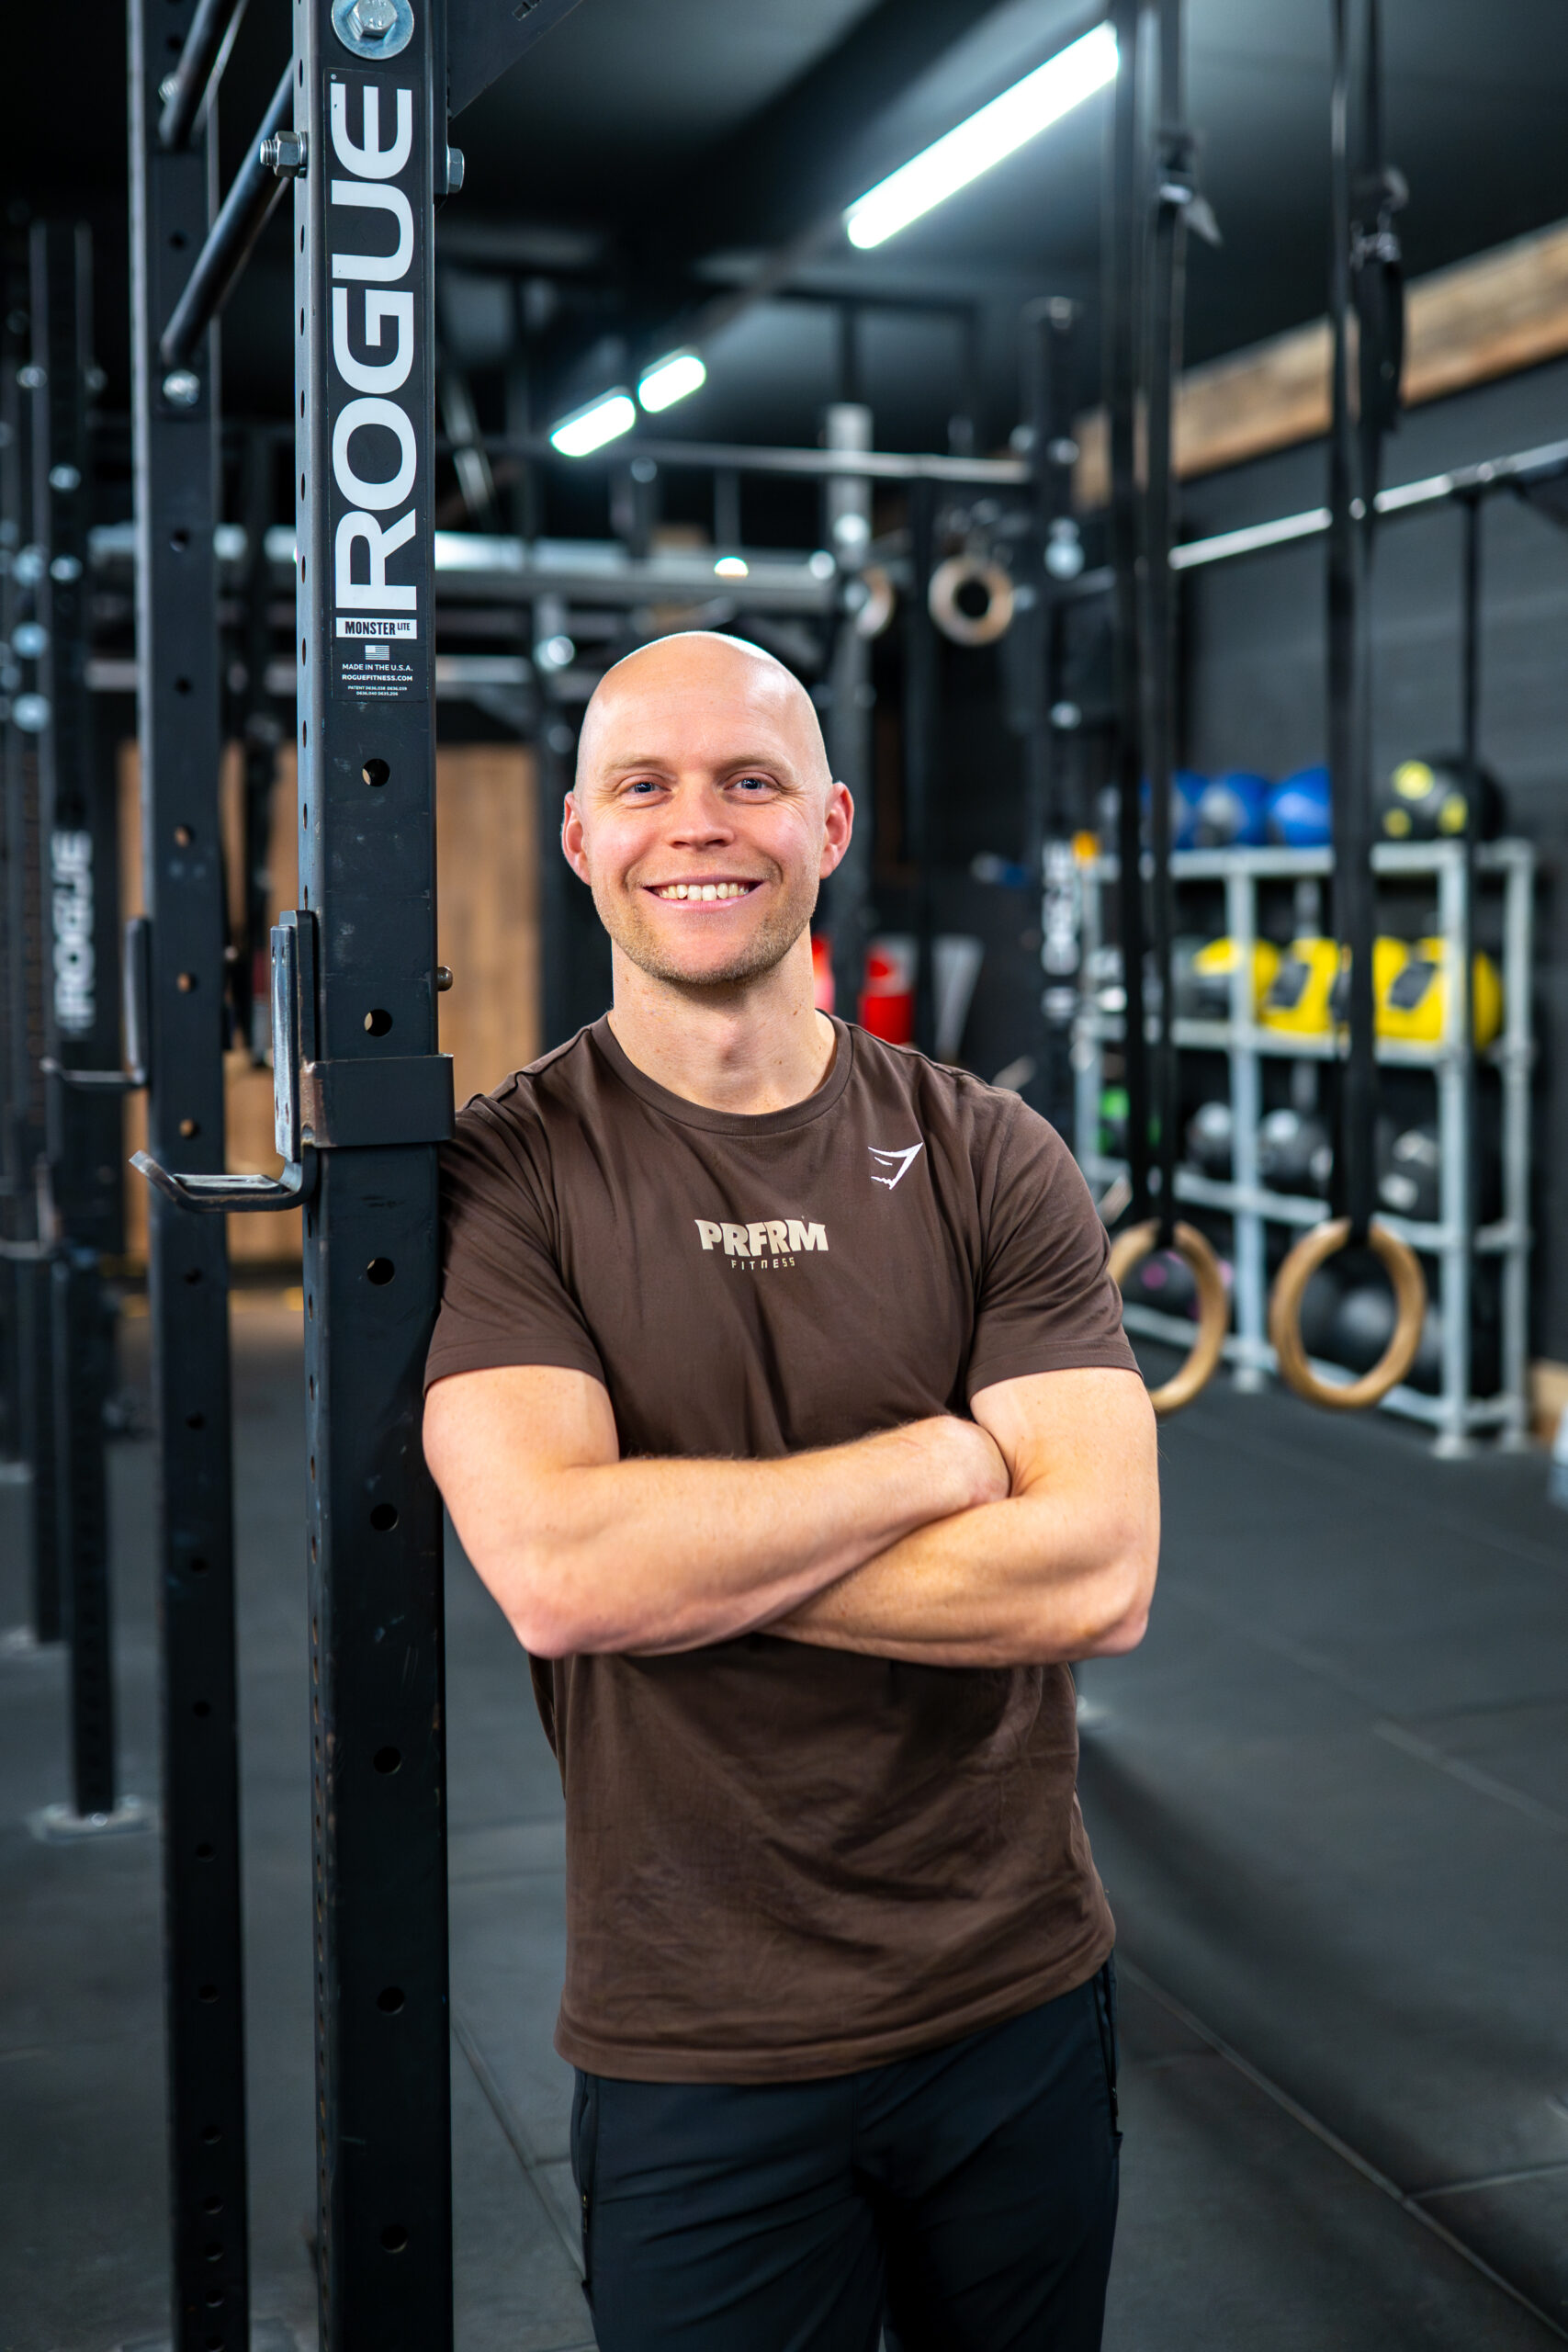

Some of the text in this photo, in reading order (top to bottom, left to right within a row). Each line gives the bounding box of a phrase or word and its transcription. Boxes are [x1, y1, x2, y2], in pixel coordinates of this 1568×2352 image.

[331, 81, 417, 610] ROGUE
[344, 621, 411, 635] MONSTER LITE
[694, 1219, 829, 1257] PRFRM
[731, 1257, 795, 1270] FITNESS
